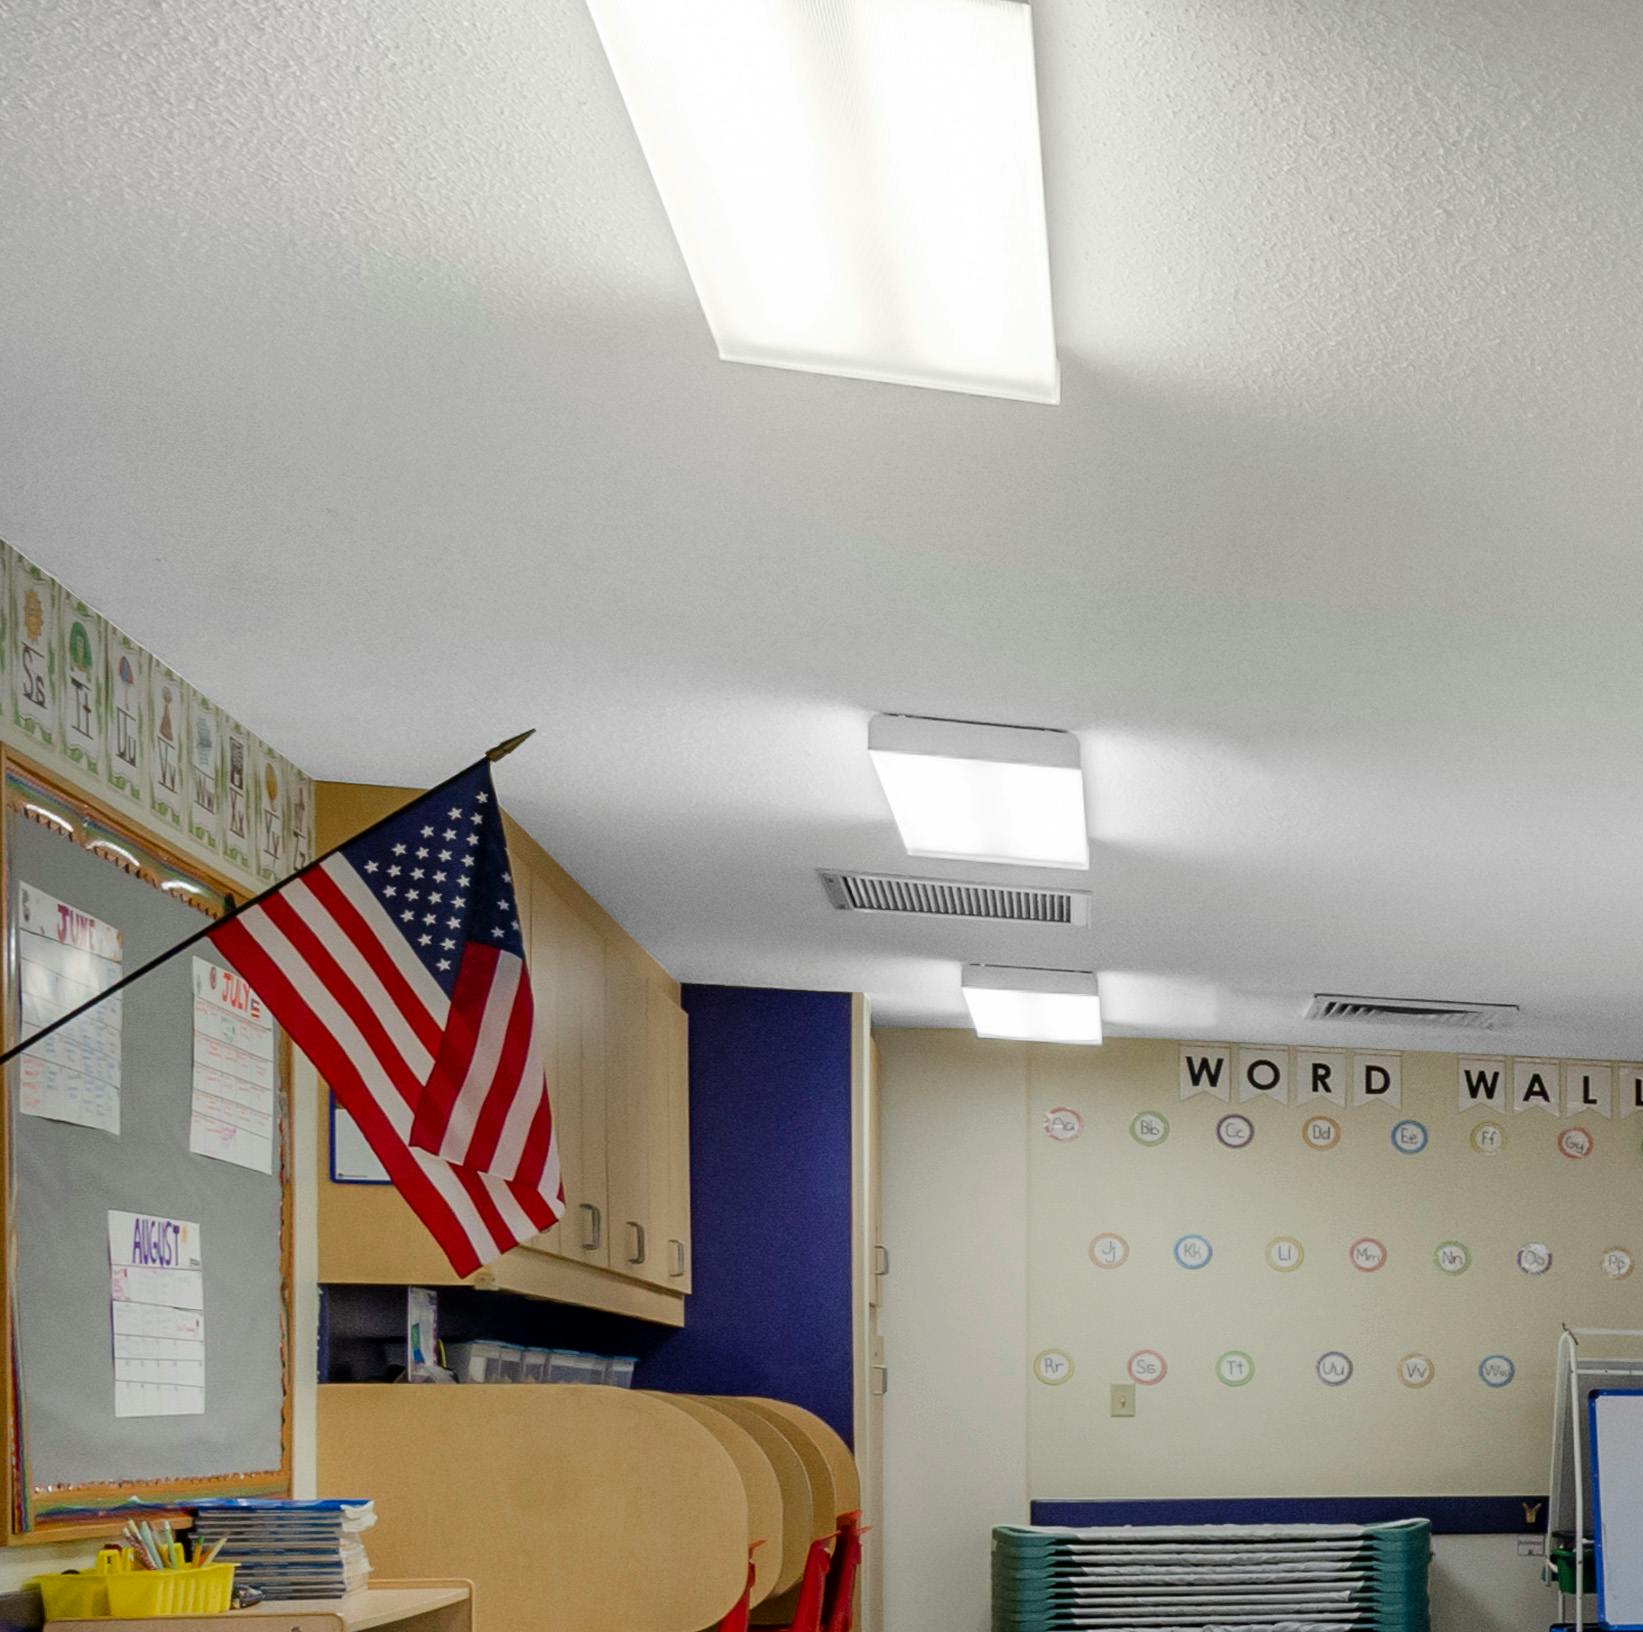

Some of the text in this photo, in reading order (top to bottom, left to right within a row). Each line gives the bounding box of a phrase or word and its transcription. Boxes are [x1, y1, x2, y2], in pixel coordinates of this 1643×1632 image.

[22, 644, 46, 708] Ss
[71, 677, 92, 738] Tt
[117, 708, 136, 767] Uu
[158, 737, 176, 792] Vv
[194, 768, 214, 813] Ww
[230, 788, 244, 837] Xx
[264, 809, 280, 868] Yy
[222, 971, 251, 1013] JULY
[1185, 1056, 1391, 1095] WORD
[1141, 1120, 1159, 1136] Bb
[1312, 1125, 1331, 1140] Dd
[1400, 1129, 1418, 1144] Ee
[1482, 1131, 1496, 1146] Ff
[132, 1217, 180, 1268] AUGUST
[1184, 1243, 1201, 1258] Kk
[1102, 1241, 1116, 1263] Jj
[1355, 1247, 1380, 1262] Mm
[1442, 1251, 1463, 1265] Nn
[1044, 1358, 1064, 1373] Rr
[1136, 1359, 1157, 1375] Ss
[1227, 1360, 1244, 1375] Tt
[1322, 1361, 1345, 1376] Uu
[1406, 1364, 1427, 1378] Vv
